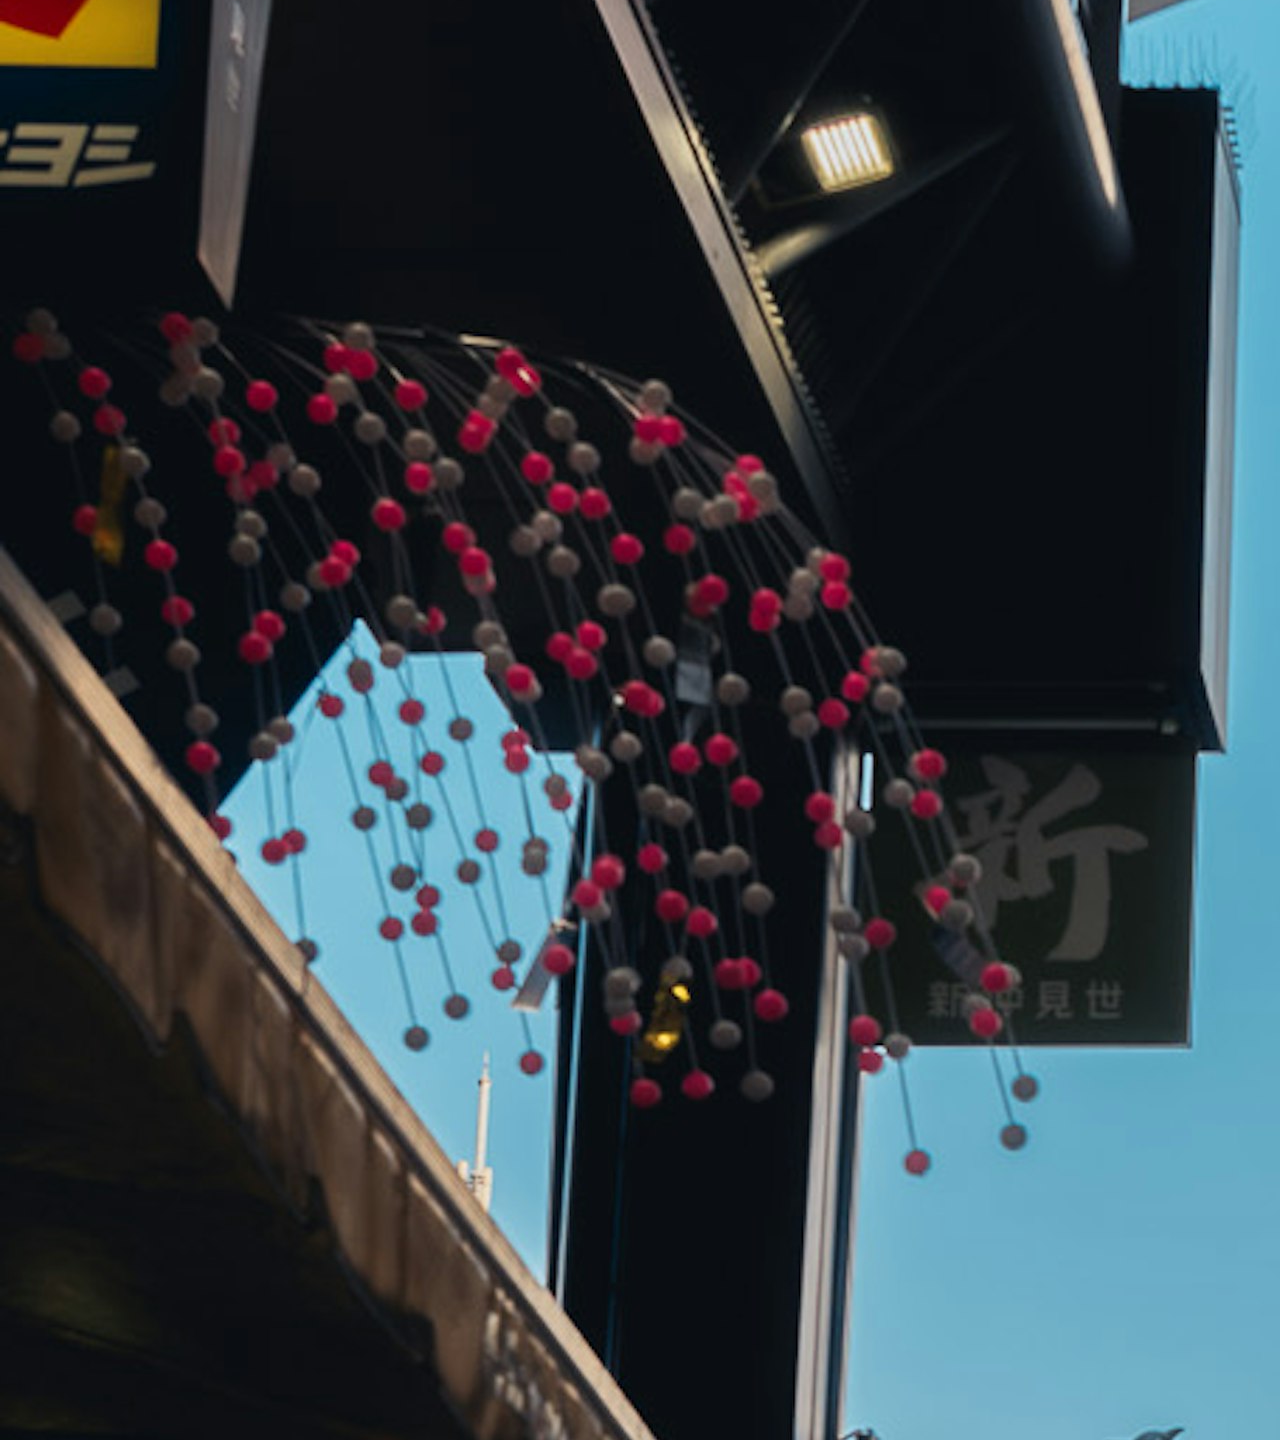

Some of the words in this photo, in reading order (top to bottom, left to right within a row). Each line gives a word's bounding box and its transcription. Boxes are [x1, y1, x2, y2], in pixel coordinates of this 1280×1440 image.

[0, 122, 158, 188] ヨシ
[912, 754, 1149, 961] 新
[926, 979, 1125, 1022] 新仲見世
